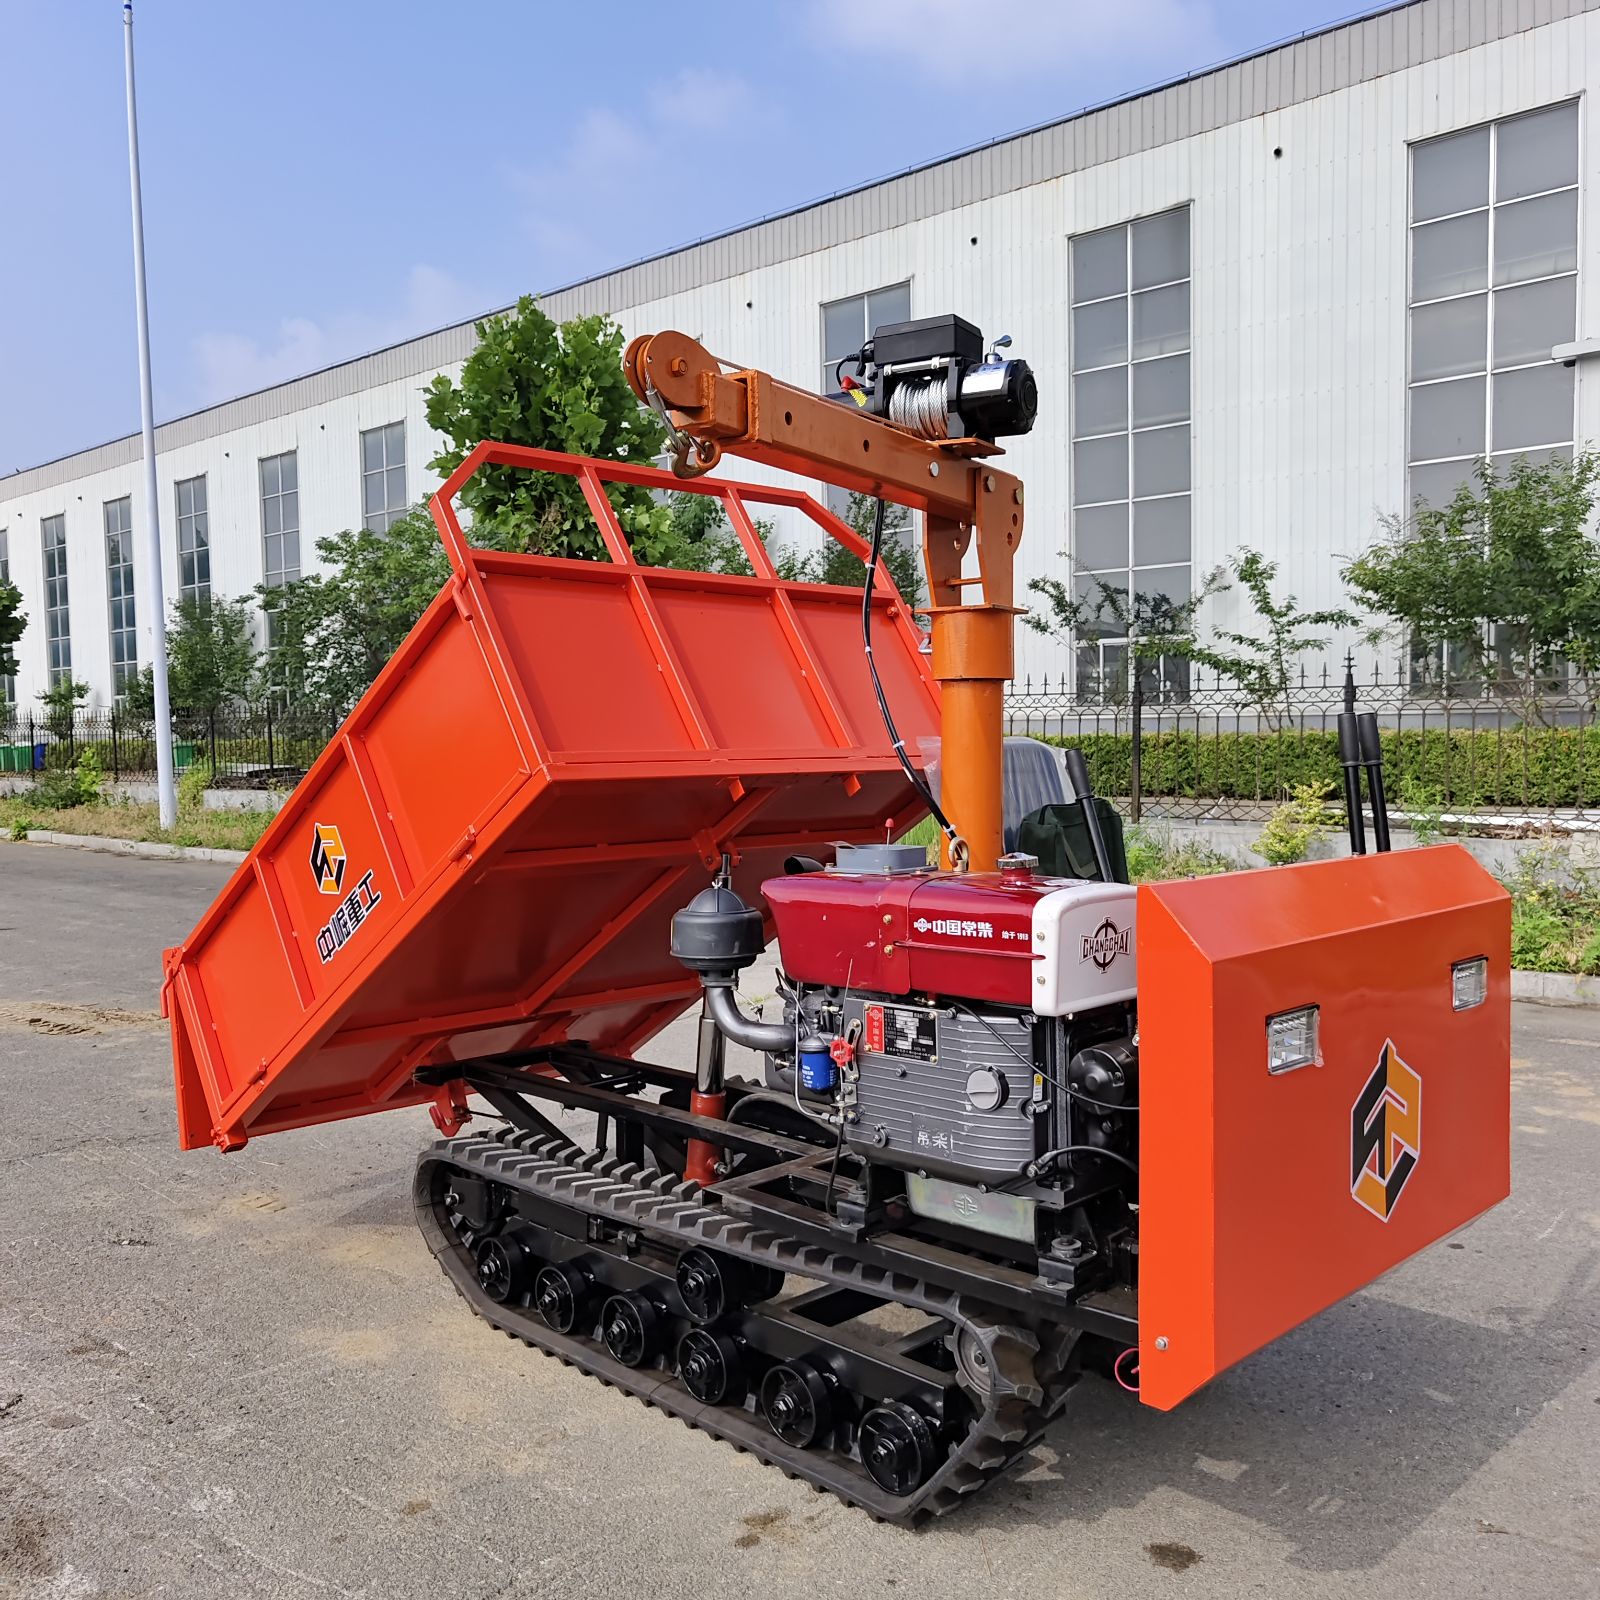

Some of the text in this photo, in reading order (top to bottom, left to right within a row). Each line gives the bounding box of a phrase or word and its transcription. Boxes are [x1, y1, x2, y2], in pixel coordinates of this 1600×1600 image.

[932, 919, 994, 938] 中国常柴
[1082, 930, 1129, 960] CHANGCHAI
